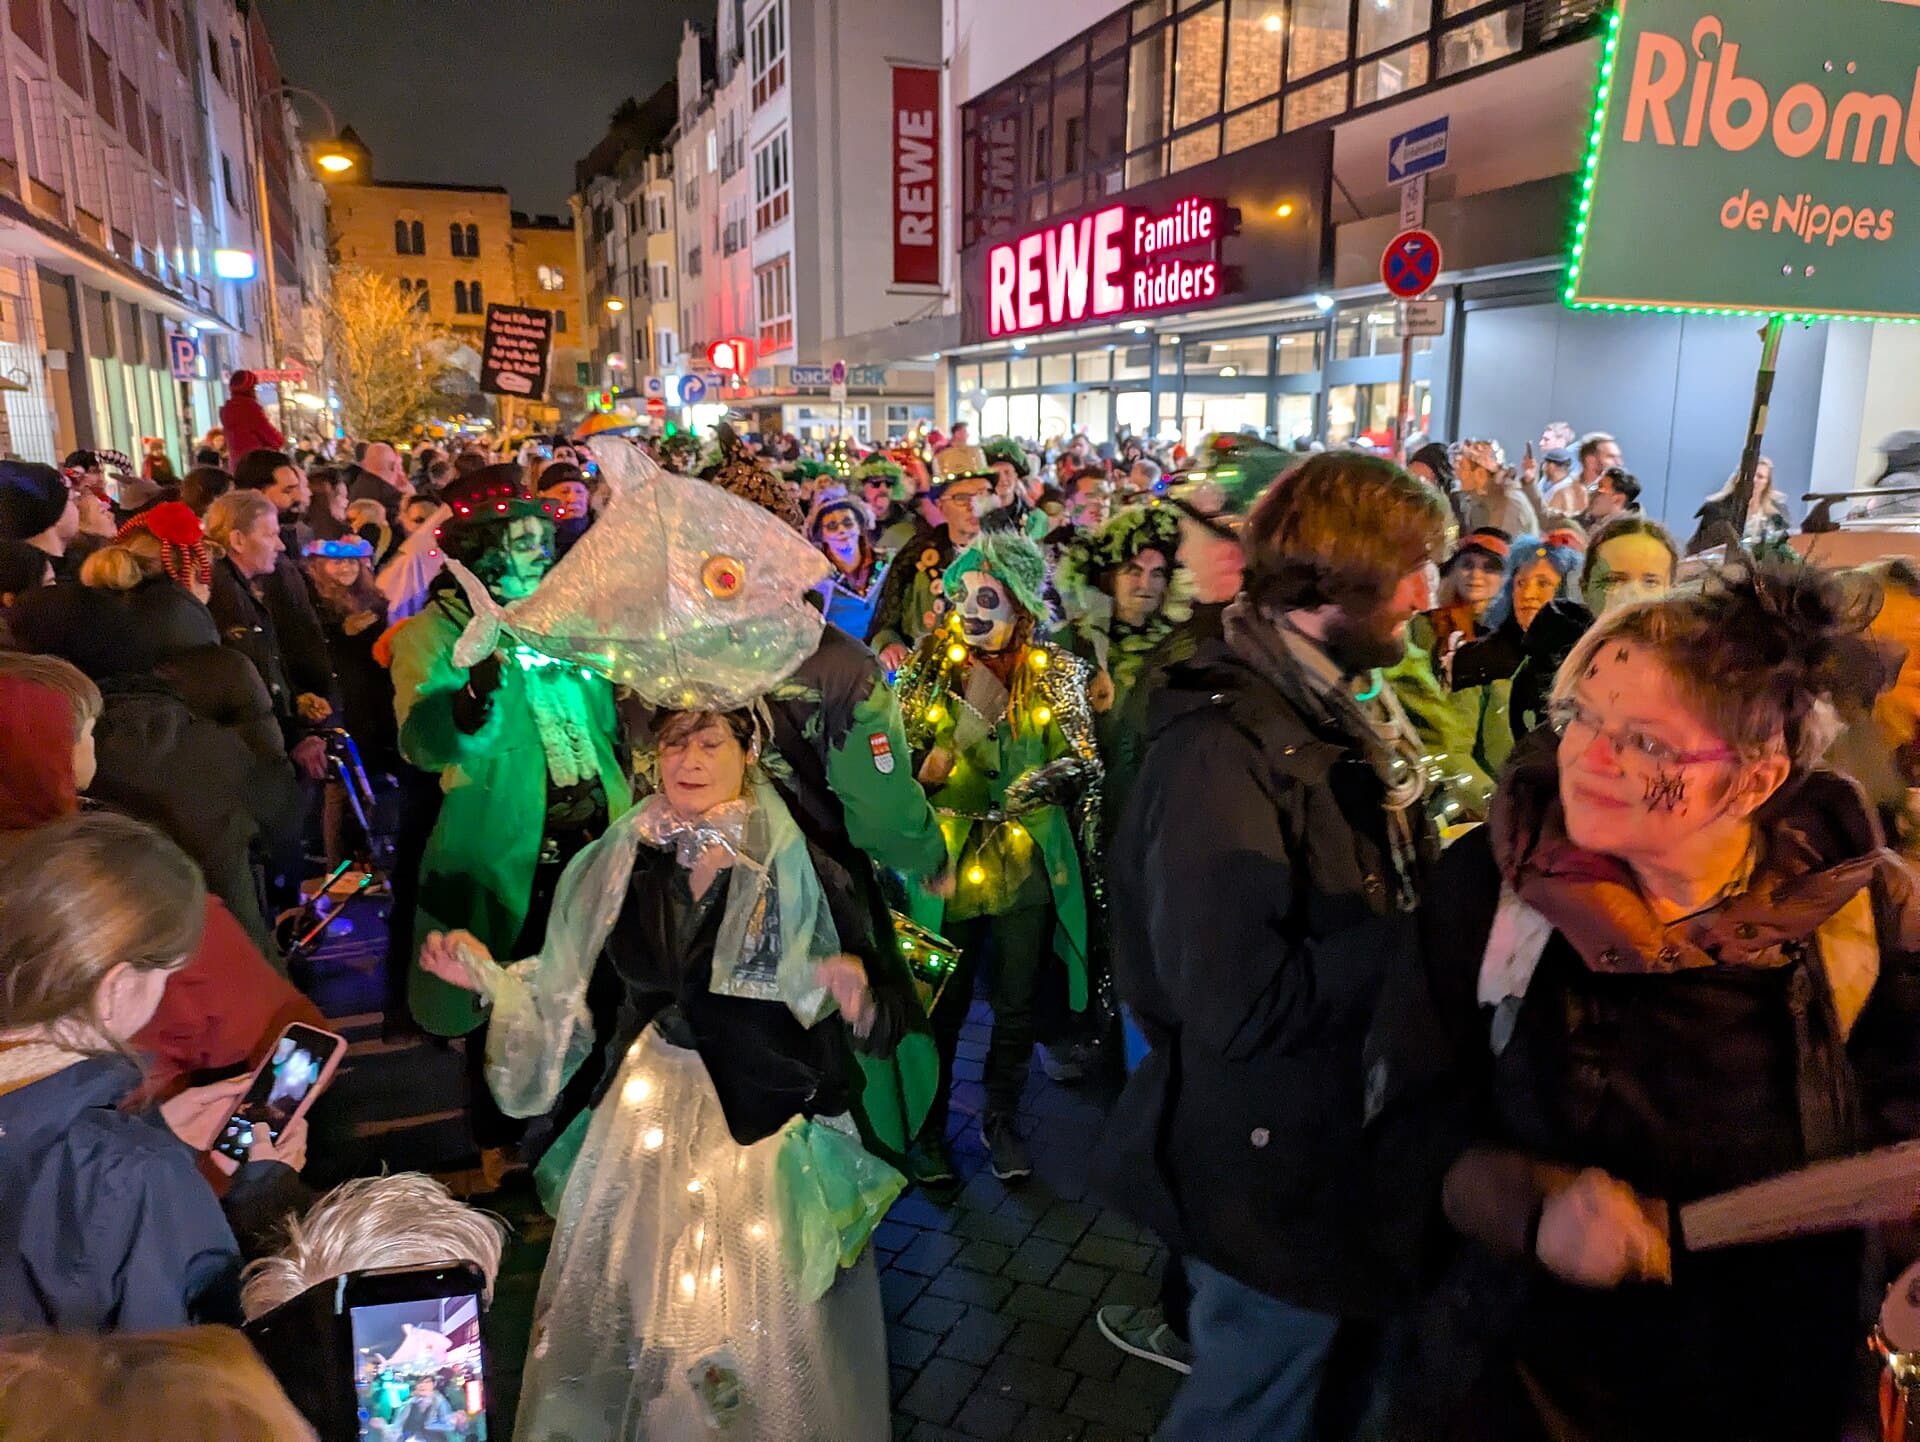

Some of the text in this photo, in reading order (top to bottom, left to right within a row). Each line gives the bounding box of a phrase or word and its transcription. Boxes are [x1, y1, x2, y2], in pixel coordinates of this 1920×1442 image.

[1622, 15, 1920, 167] Ribom
[899, 108, 934, 247] REWE
[1720, 188, 1895, 247] de Nippes
[988, 206, 1126, 336] REWE
[1133, 198, 1213, 256] Familie
[1133, 261, 1216, 309] Ridders
